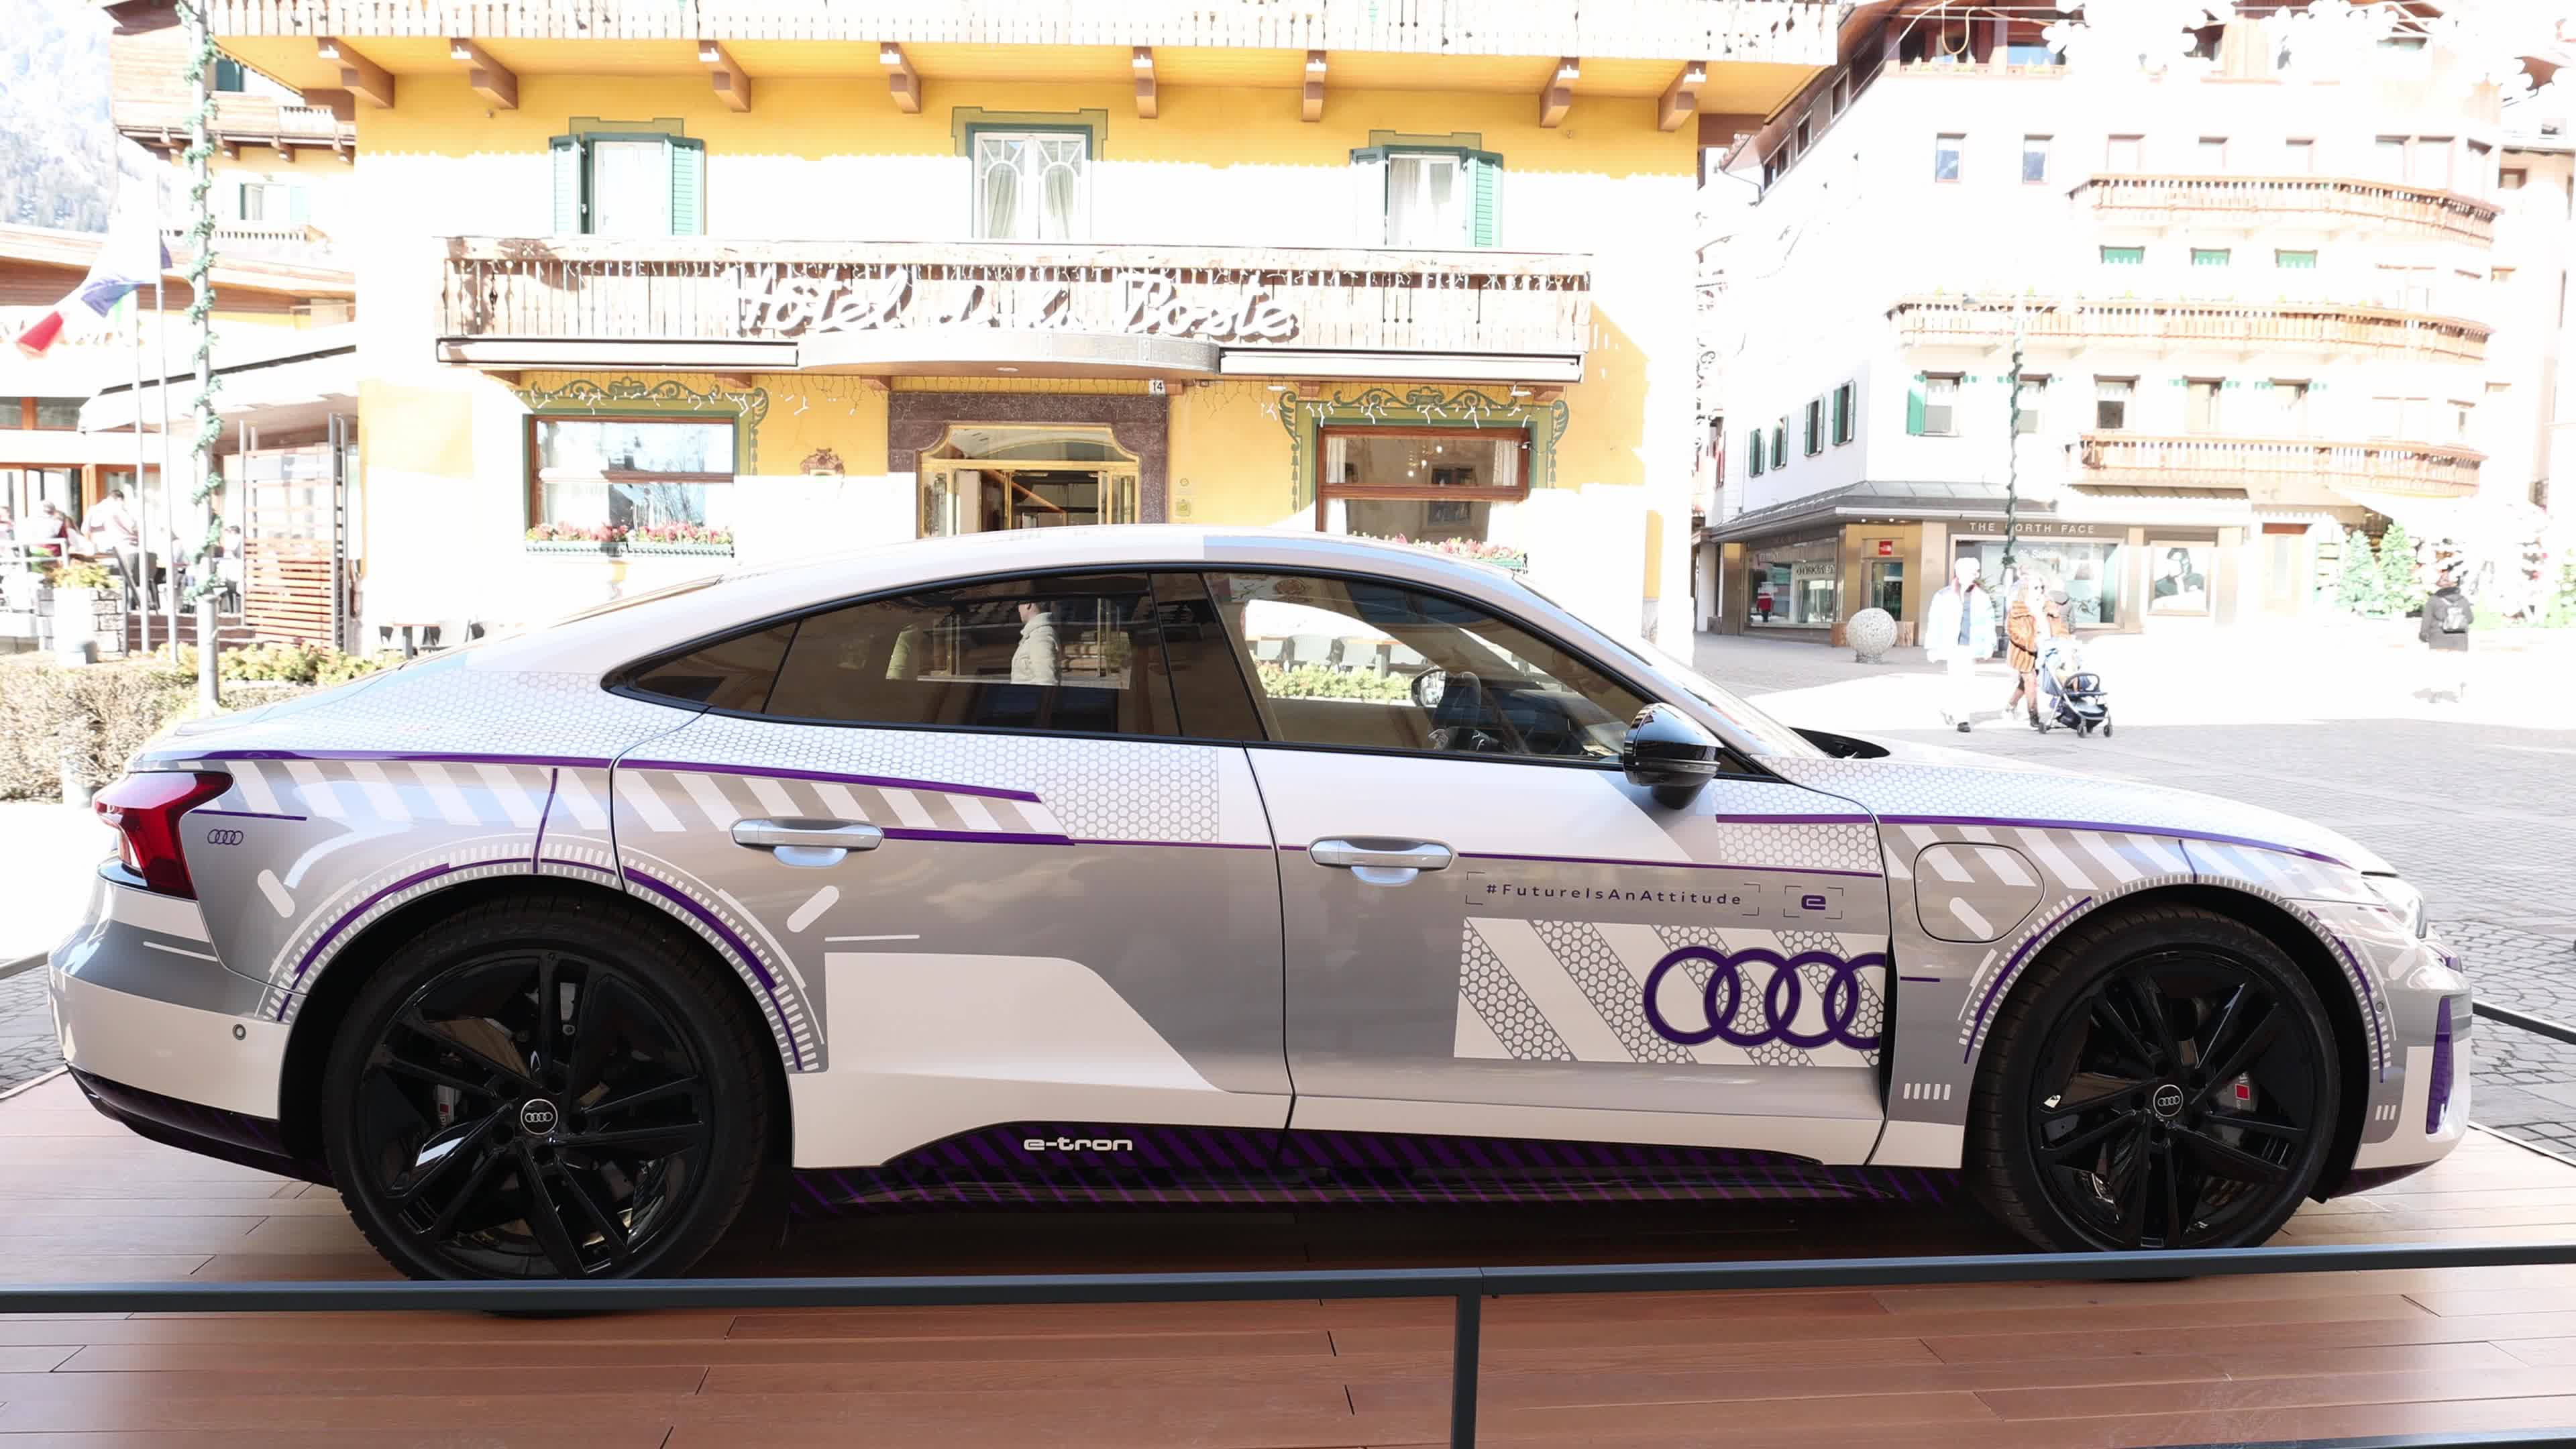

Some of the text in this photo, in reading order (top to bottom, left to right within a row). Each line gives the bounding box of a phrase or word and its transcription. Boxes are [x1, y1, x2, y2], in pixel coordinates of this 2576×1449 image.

[1112, 271, 1293, 335] Poste
[1152, 381, 1163, 392] 14
[1969, 522, 1995, 532] THE
[2061, 525, 2094, 534] FACE
[1487, 883, 1742, 906] #FutureIsAnAttitude
[1024, 1136, 1133, 1151] e-tron
